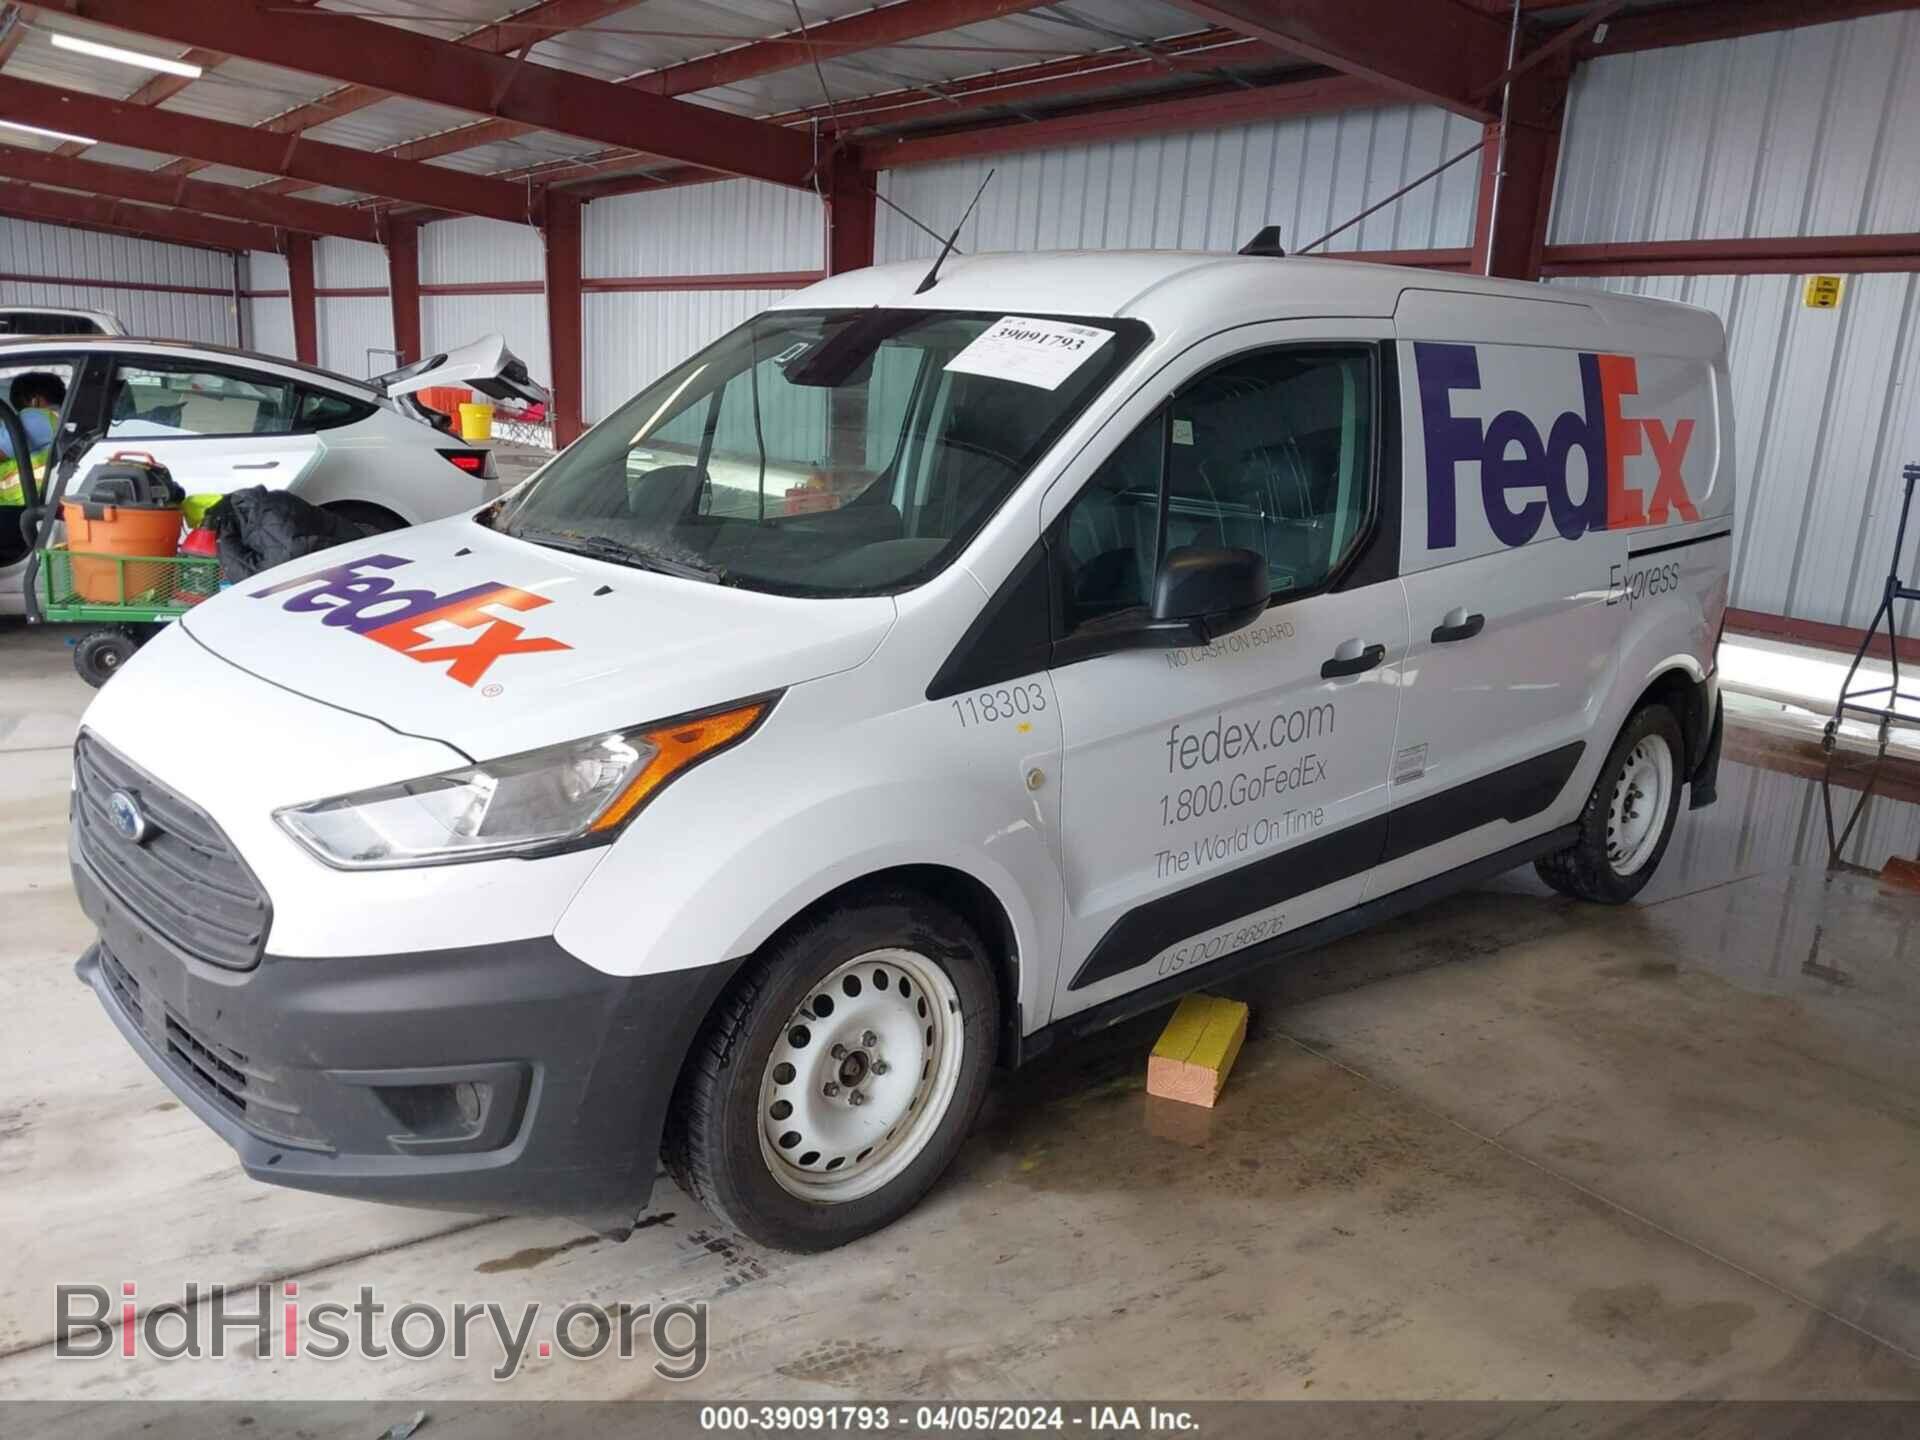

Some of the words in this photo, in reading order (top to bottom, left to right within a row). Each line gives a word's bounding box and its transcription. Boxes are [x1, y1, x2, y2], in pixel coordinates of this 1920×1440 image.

[991, 327, 1085, 351] 39091793
[1413, 342, 1701, 549] FedEx
[1606, 562, 1680, 610] Express
[246, 554, 576, 688] FedEx
[1165, 649, 1188, 669] NO
[1191, 639, 1228, 662] CASH
[1229, 632, 1250, 653] ON
[1251, 621, 1296, 646] BOARD
[951, 683, 1046, 727] 118303
[1166, 703, 1335, 773] fedex.com
[1159, 753, 1327, 826] 1.800.GoFedEx
[1154, 849, 1190, 879] The
[1194, 826, 1249, 865] World
[1254, 817, 1280, 846] On
[1282, 806, 1325, 838] Time
[1158, 948, 1188, 976] US
[1189, 932, 1234, 965] DOT
